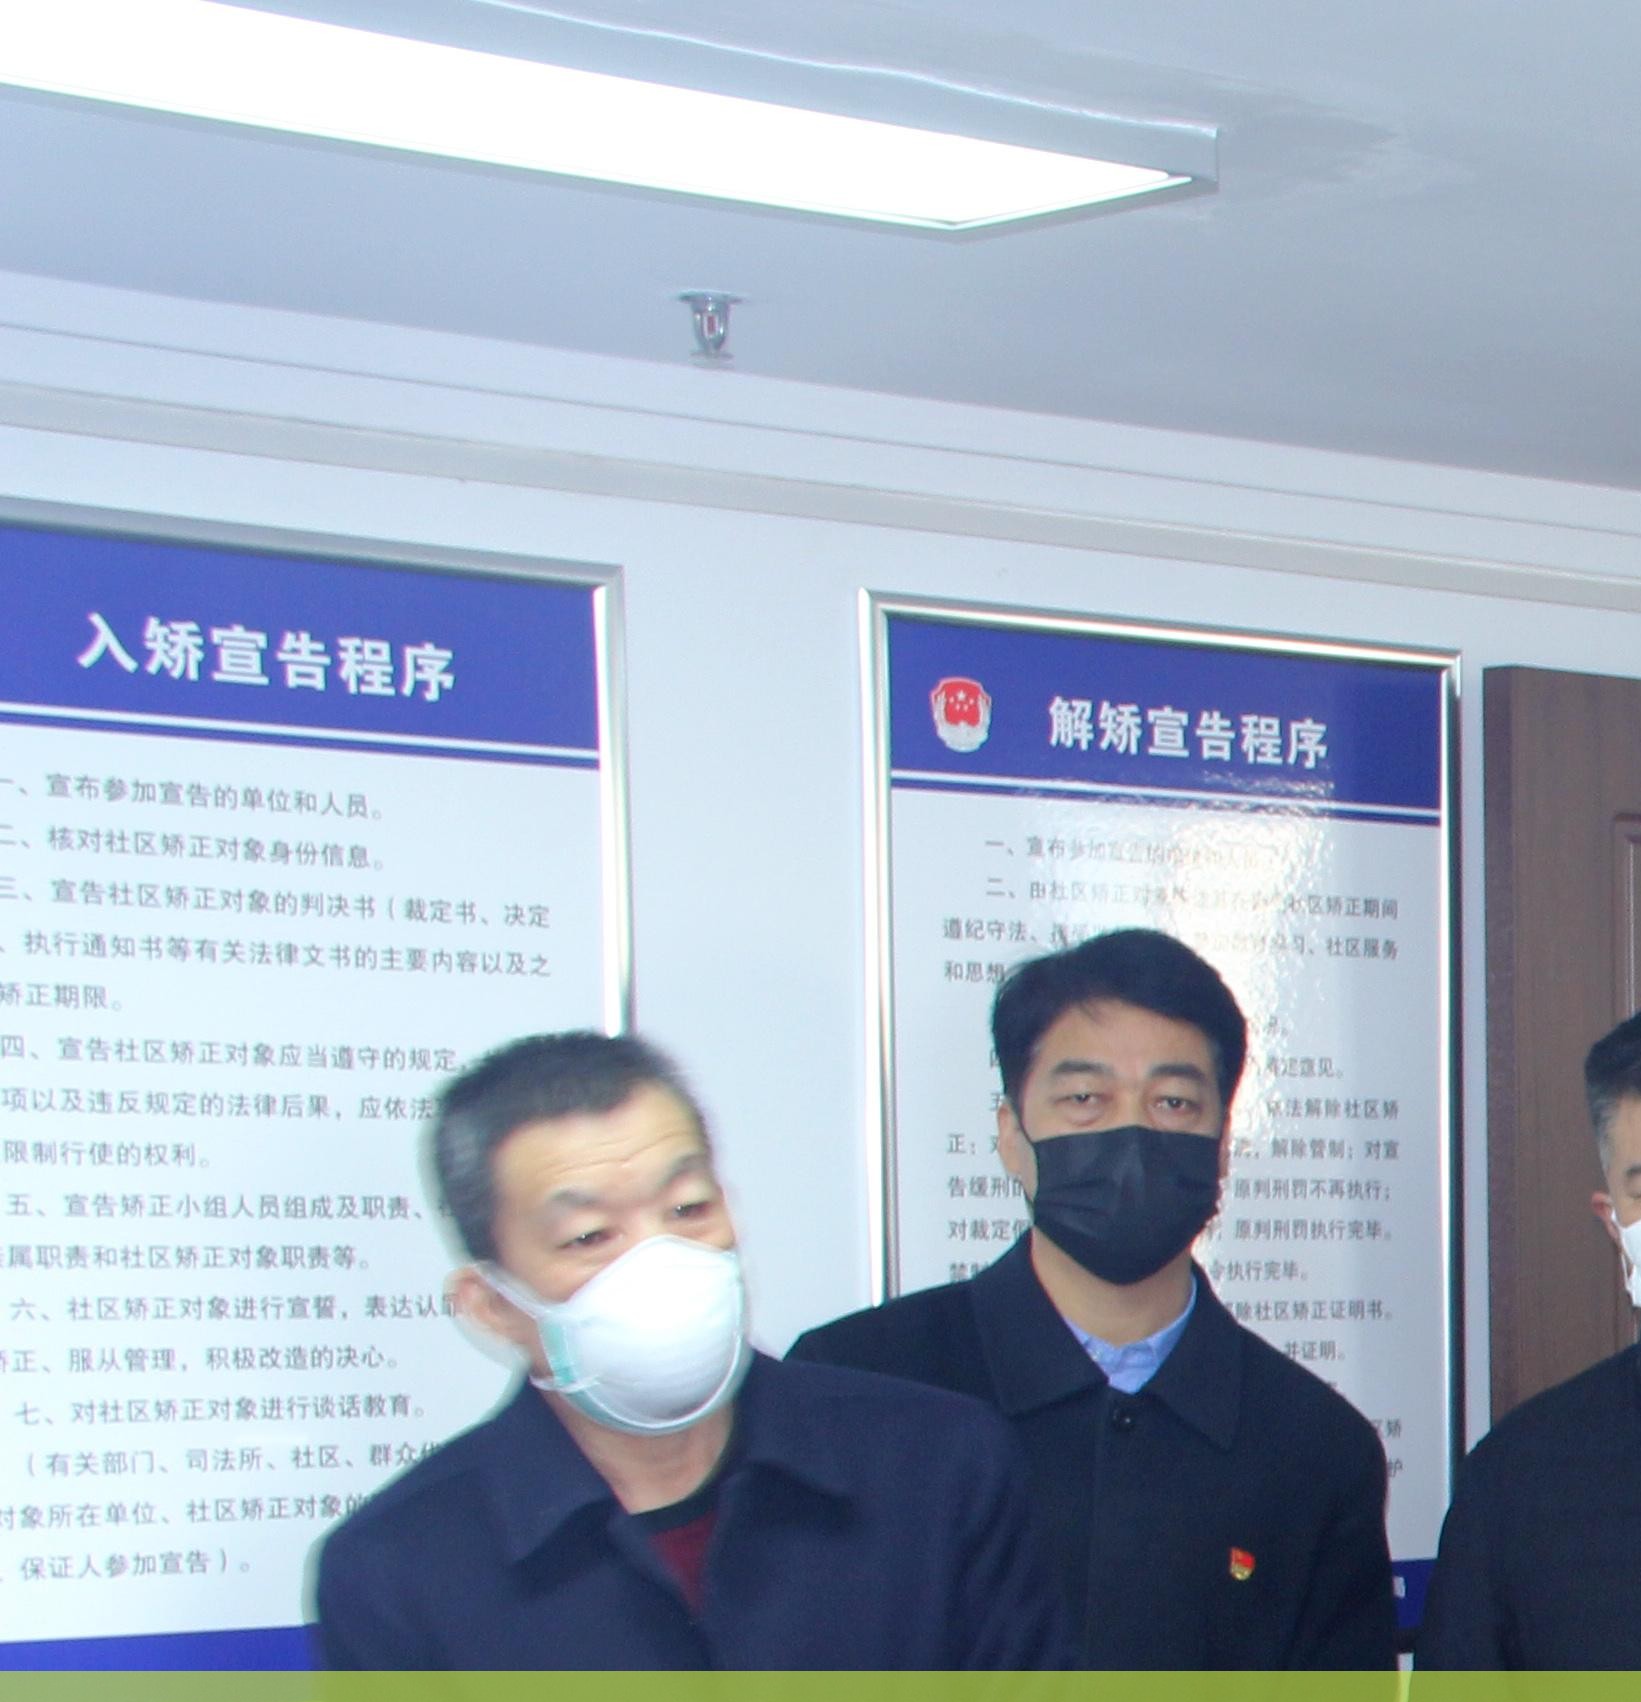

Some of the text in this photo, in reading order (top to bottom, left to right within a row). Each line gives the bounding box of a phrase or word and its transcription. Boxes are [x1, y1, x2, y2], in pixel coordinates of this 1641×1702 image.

[77, 611, 456, 703] 入矫宣告程序
[1048, 695, 1329, 770] 解矫宣告程序
[6, 1193, 450, 1220] 五、宣告矫正小组人员组成及职责、
[0, 1245, 369, 1271] 属职责和社区矫正对象职责等。
